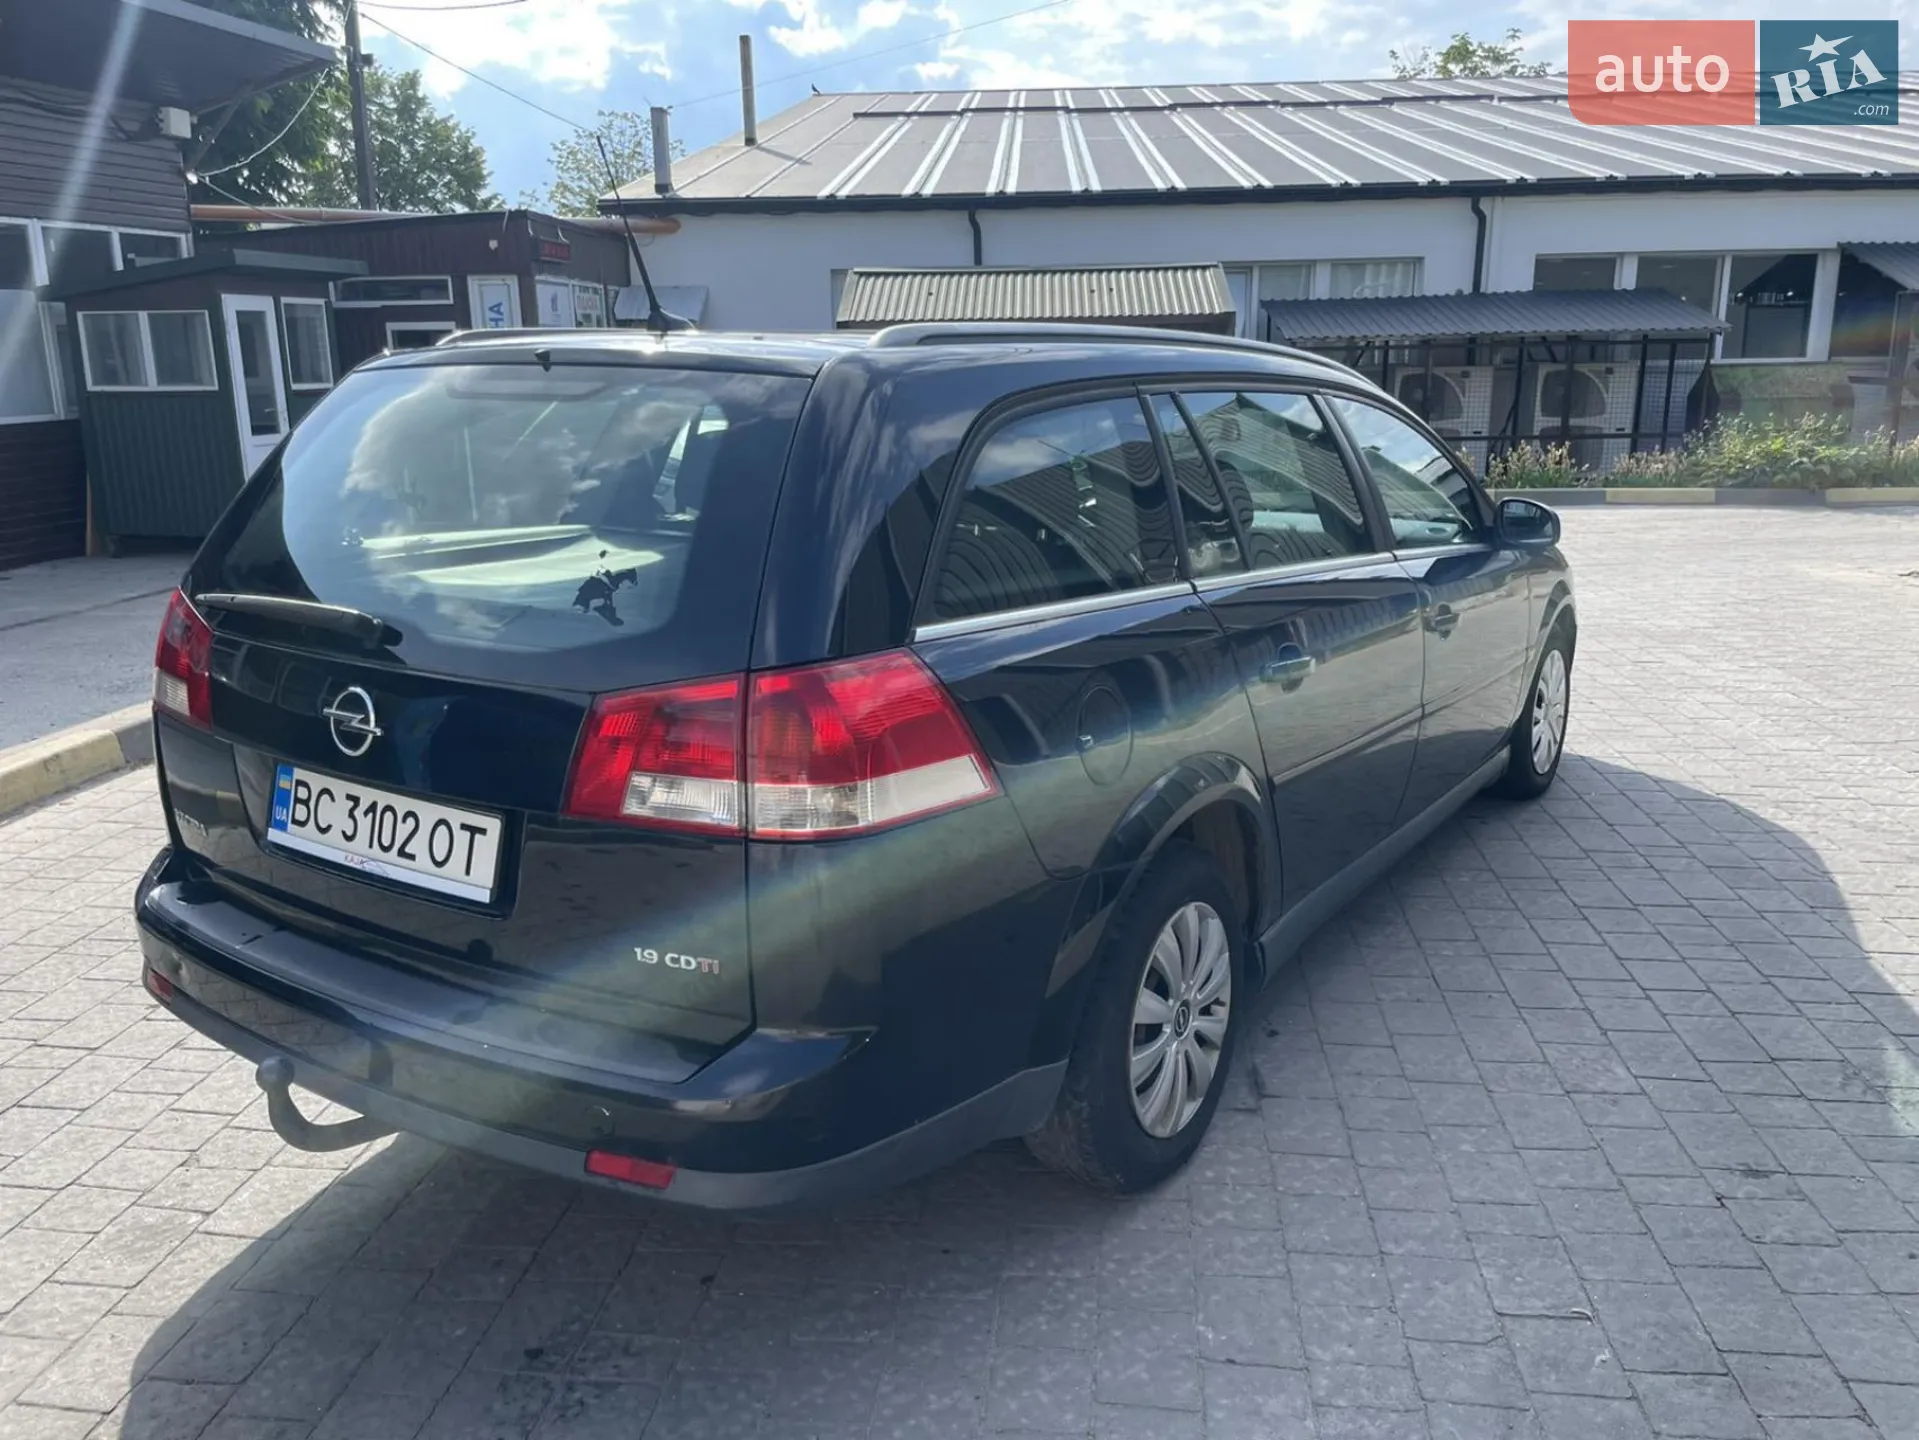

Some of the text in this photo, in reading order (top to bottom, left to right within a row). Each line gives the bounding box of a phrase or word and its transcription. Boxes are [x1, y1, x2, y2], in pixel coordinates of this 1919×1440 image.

[275, 807, 288, 823] UA
[291, 778, 488, 877] BC 3102 OT
